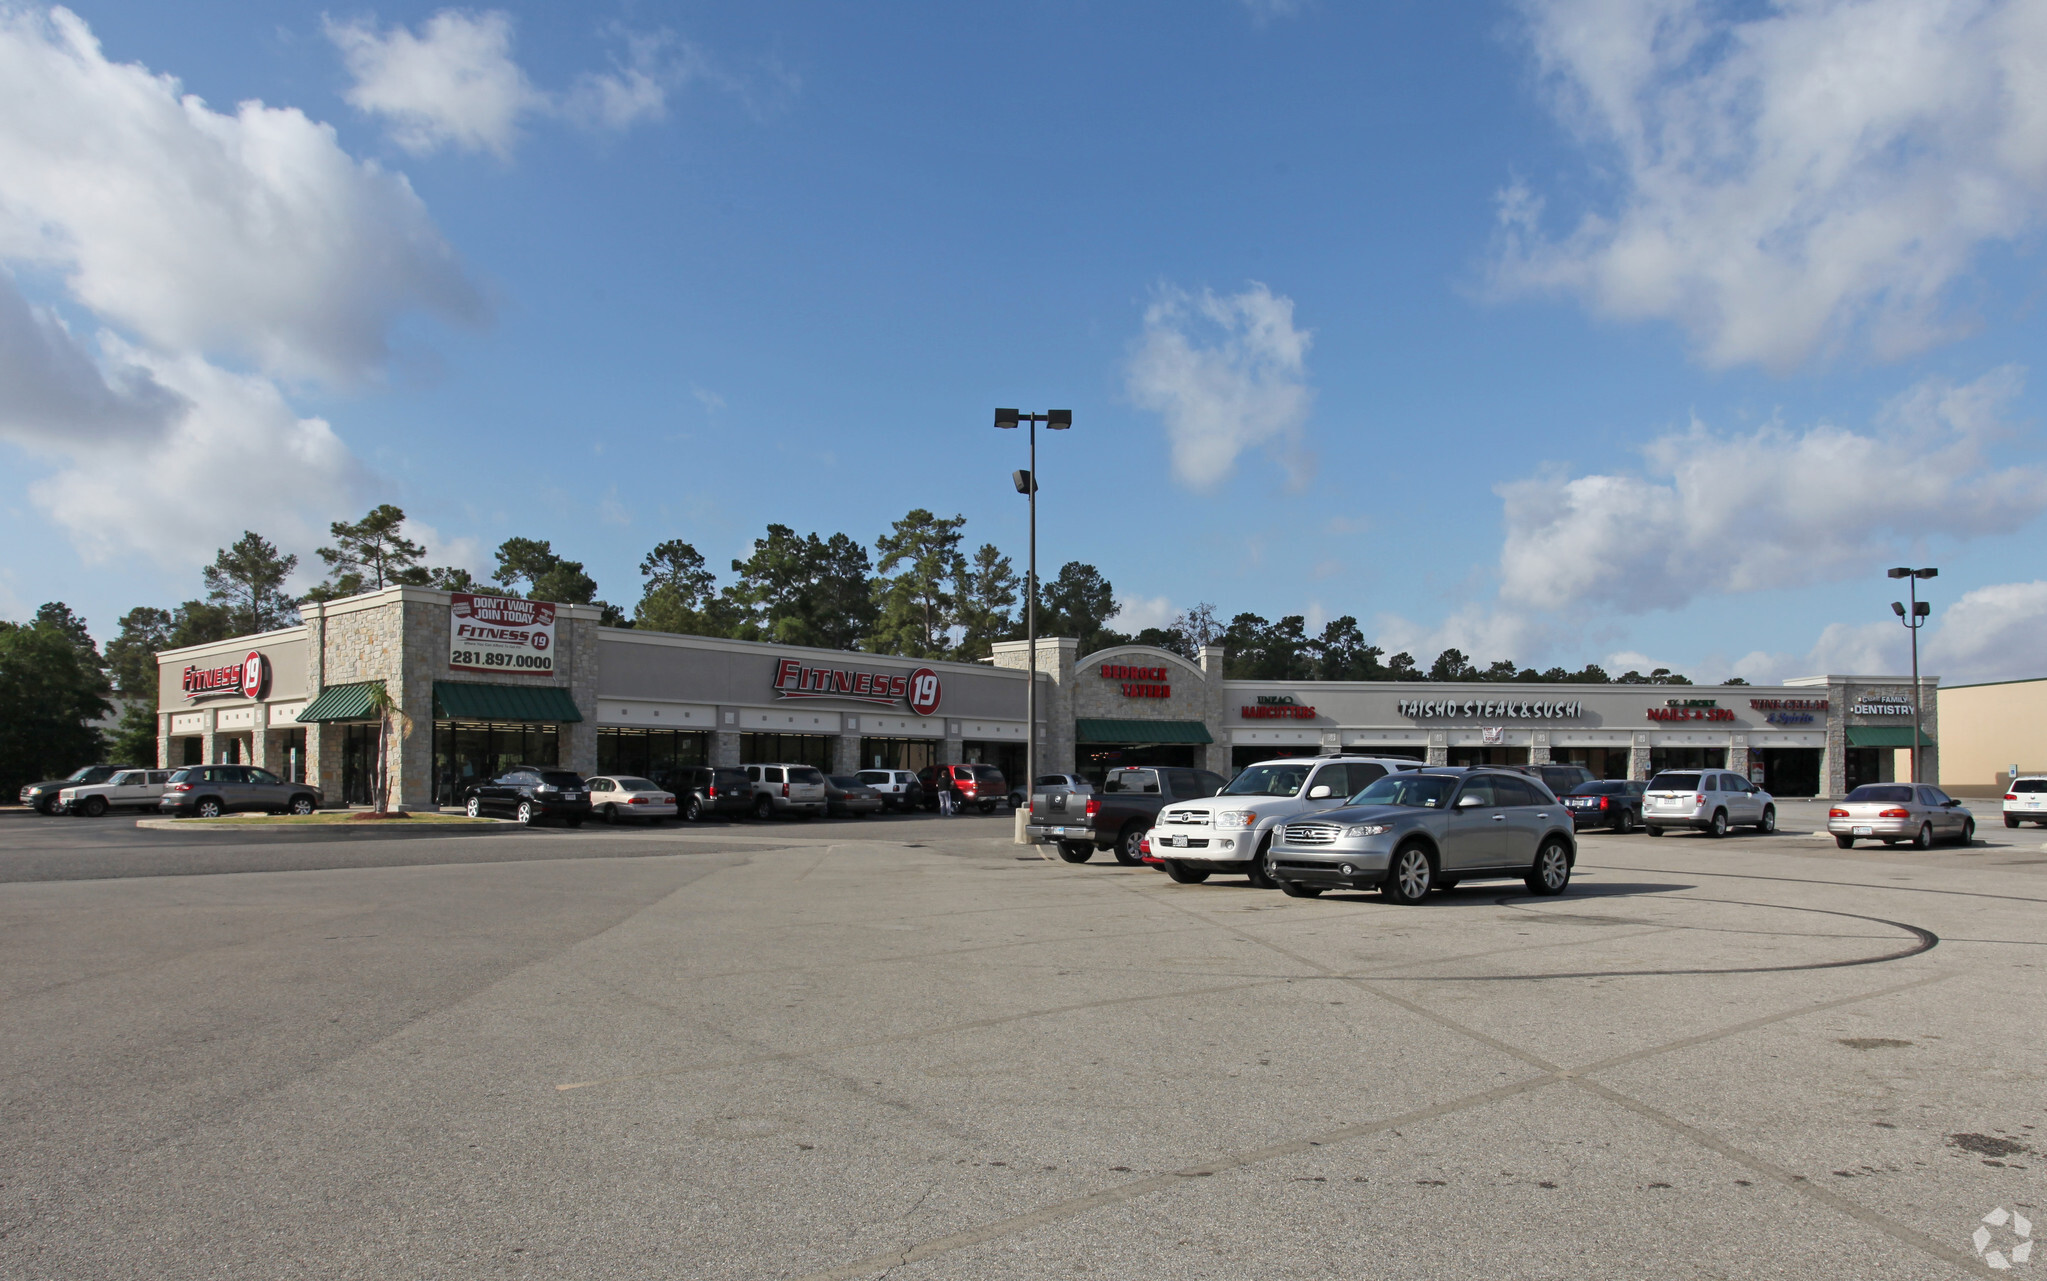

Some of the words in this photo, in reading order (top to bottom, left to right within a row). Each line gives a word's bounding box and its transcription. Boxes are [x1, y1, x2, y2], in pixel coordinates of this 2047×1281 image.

[473, 597, 505, 609] DON'T
[507, 600, 535, 614] WAIT.
[475, 609, 500, 620] JOIN
[502, 610, 534, 624] TODAY
[457, 624, 530, 641] FITNESS
[533, 635, 546, 646] 19
[452, 650, 551, 669] 281.897.0000
[182, 664, 241, 691] FITNESS
[245, 658, 260, 689] 19
[1101, 665, 1168, 681] BEDROCK
[774, 658, 907, 696] FITNESS
[913, 675, 938, 706] 19
[1241, 706, 1316, 719] HAIRCUTTERS
[1400, 700, 1457, 718] TAISHO
[1750, 699, 1781, 710] WINE
[1854, 705, 1914, 715] DENTISTRY
[1647, 708, 1691, 721] NAILS
[1694, 710, 1704, 720] &
[1707, 708, 1735, 722] SPA
